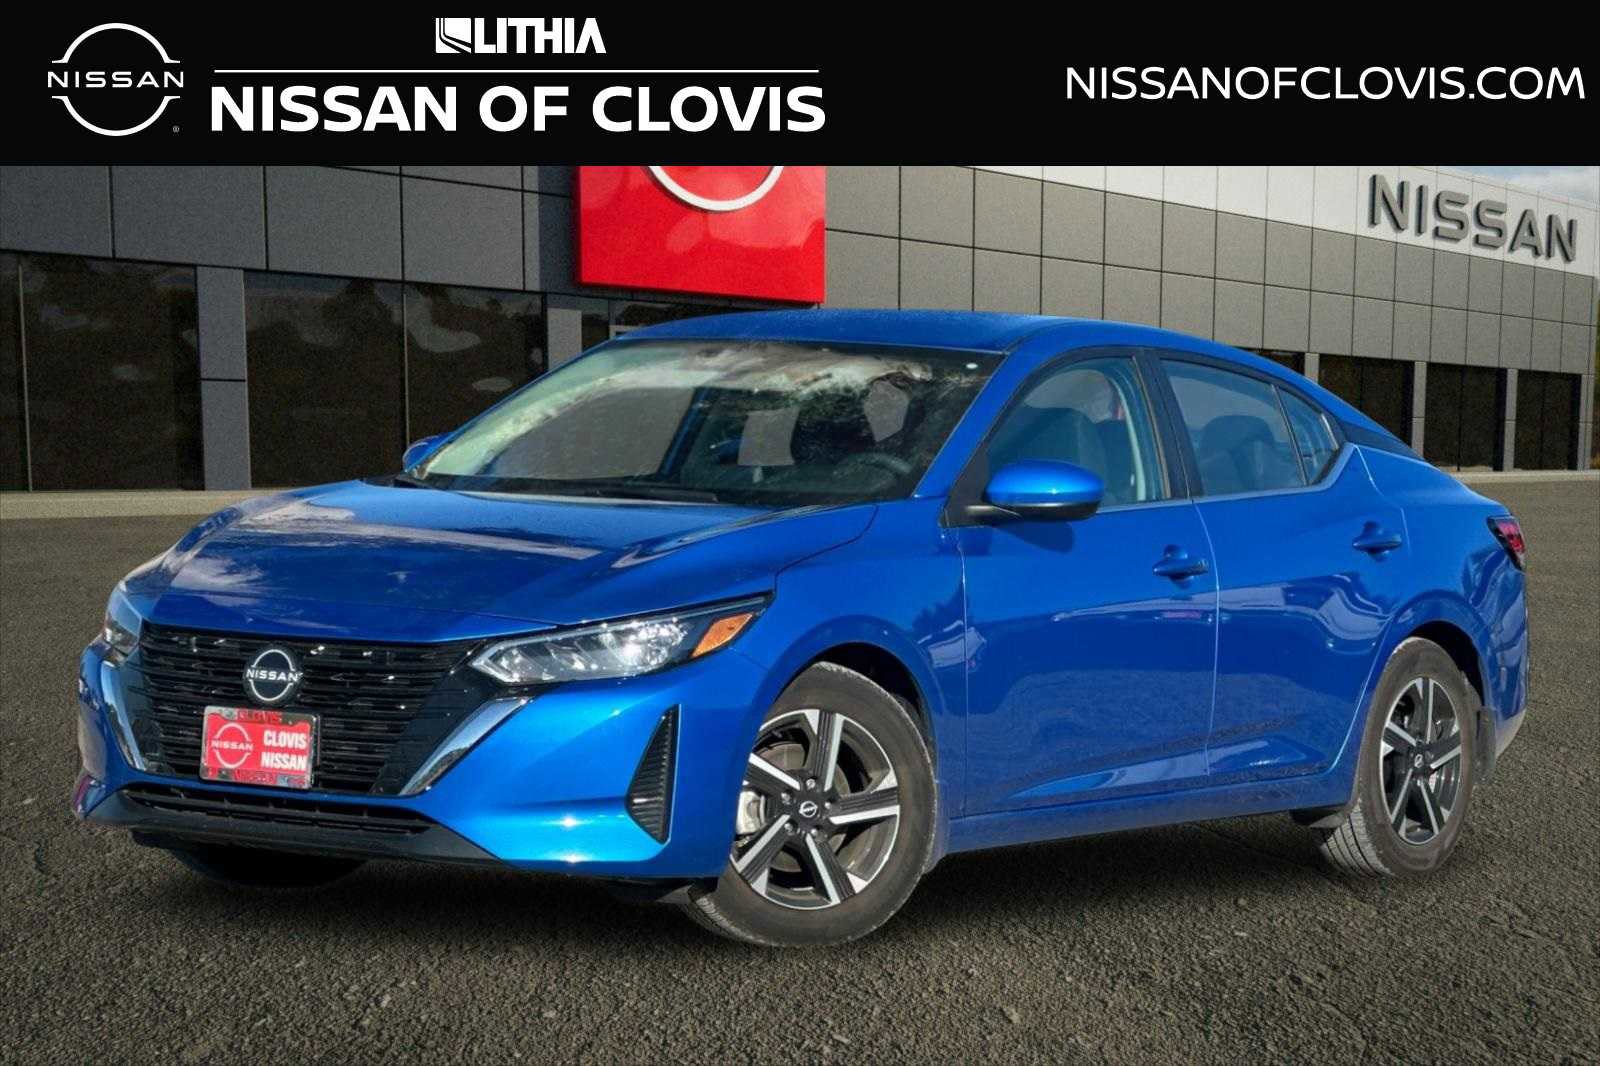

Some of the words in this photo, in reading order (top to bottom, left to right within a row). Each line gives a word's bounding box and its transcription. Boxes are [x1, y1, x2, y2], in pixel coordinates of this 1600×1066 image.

[1368, 173, 1578, 264] NISSAN
[246, 668, 299, 682] NISSAN
[210, 740, 254, 751] NISSAN
[263, 730, 307, 749] CLOVIS
[260, 751, 308, 771] NISSAN
